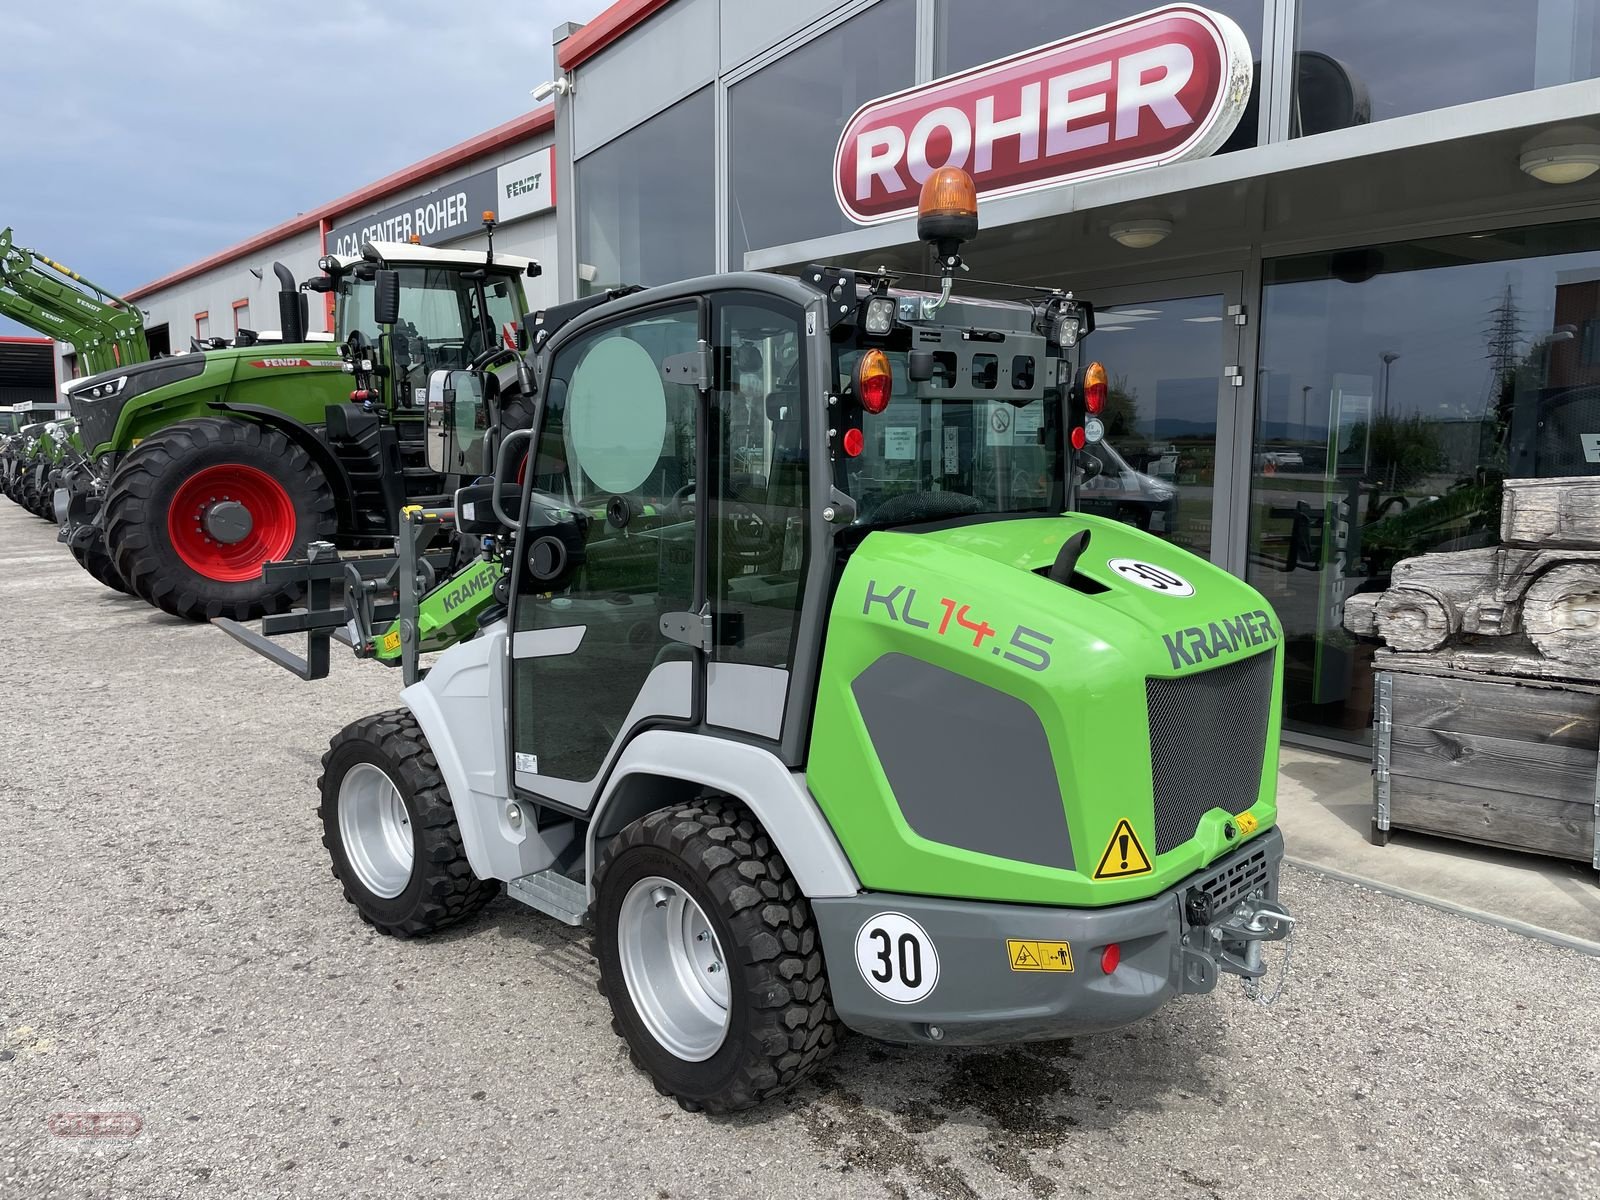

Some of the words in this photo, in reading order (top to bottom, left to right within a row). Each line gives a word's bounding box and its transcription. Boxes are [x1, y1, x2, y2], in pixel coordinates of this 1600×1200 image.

[856, 43, 1195, 201] ROHER
[505, 173, 542, 199] FENDT
[415, 192, 468, 236] ROHER
[41, 311, 64, 324] FENDT
[76, 298, 102, 312] FENDT
[263, 358, 302, 367] FENDT
[442, 565, 499, 614] KRAMER
[1121, 563, 1185, 590] 30
[1161, 609, 1277, 670] KRAMER
[869, 927, 923, 989] 30
